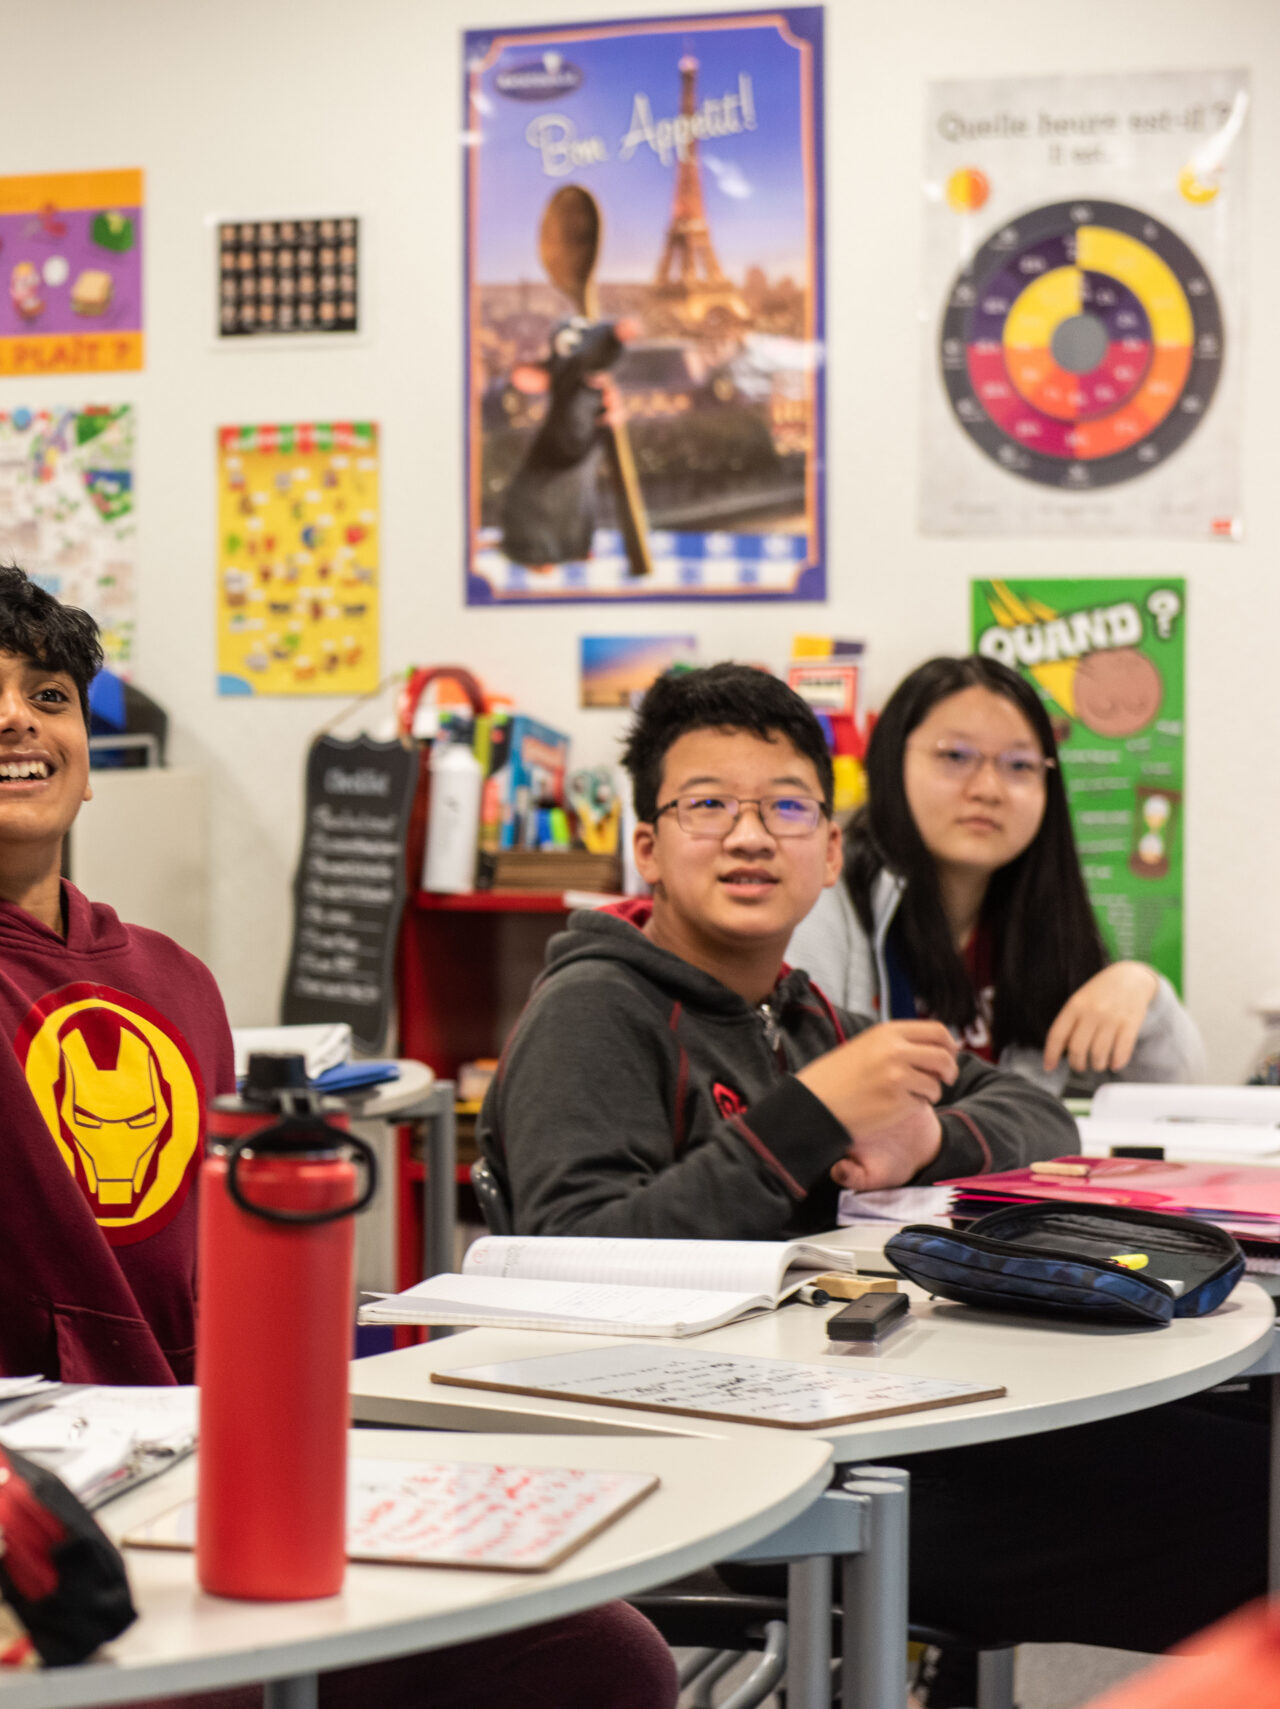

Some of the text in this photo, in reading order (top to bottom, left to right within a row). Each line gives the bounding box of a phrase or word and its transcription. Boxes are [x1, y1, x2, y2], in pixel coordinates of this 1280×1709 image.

[525, 114, 608, 177] Bon
[937, 110, 1029, 144] Quelle
[1038, 111, 1117, 139] heure
[1128, 107, 1207, 136] est-il
[977, 588, 1181, 669] QUAND ?
